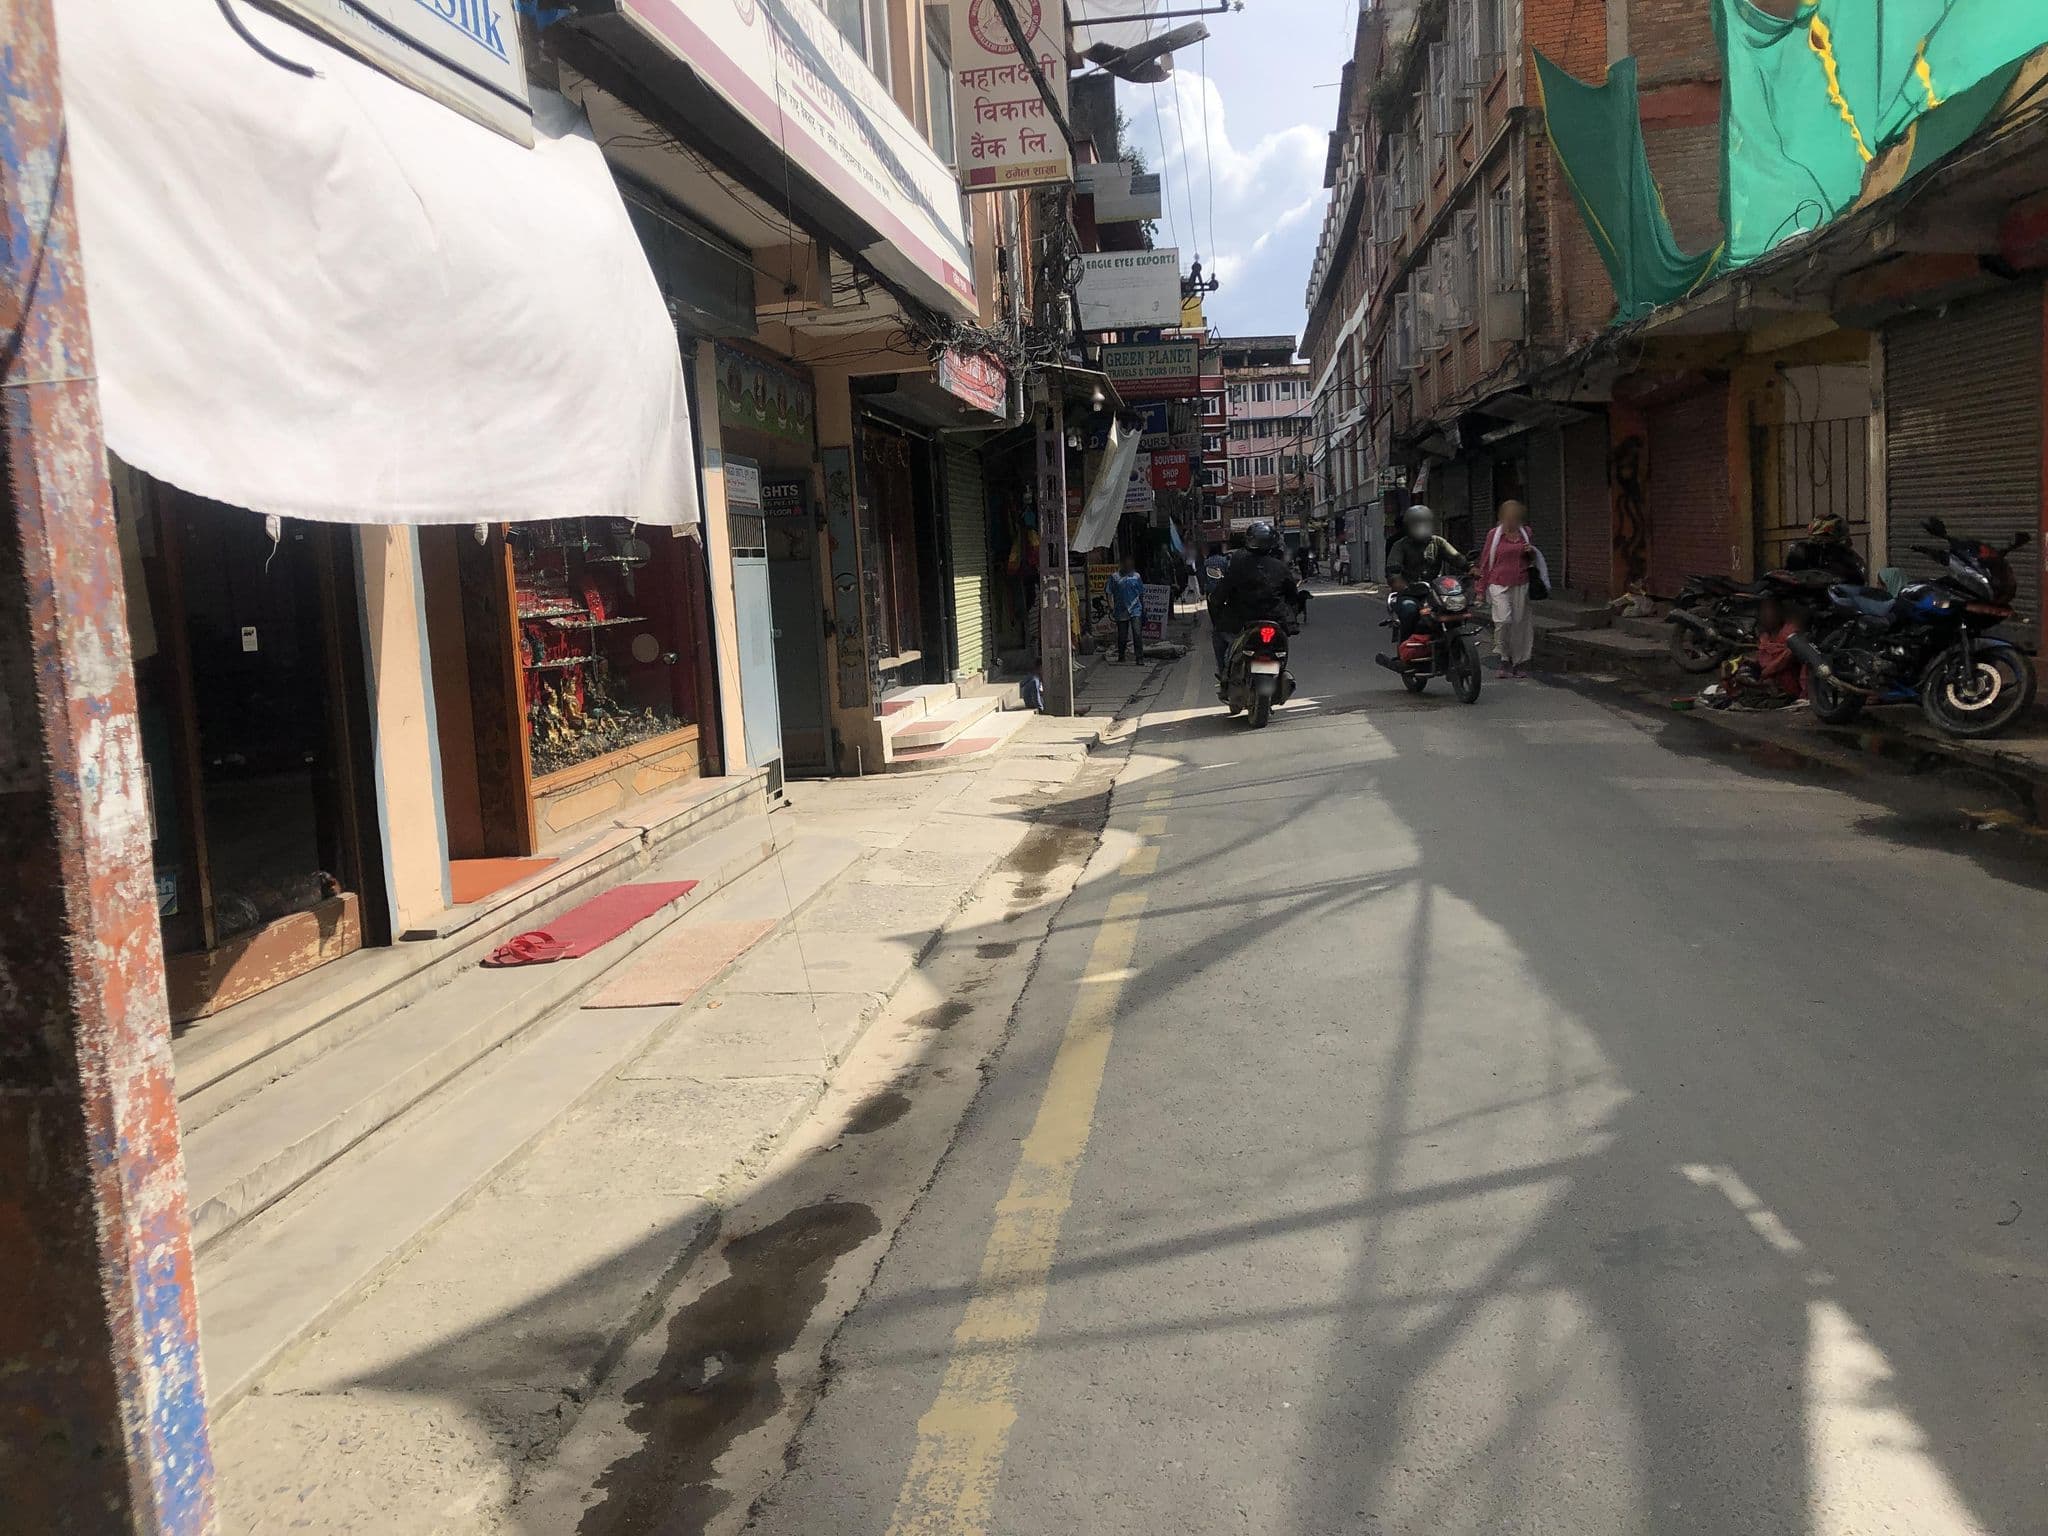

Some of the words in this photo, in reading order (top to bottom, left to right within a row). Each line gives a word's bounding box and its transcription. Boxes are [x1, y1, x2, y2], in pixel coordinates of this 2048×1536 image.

[974, 96, 1045, 124] विकास
[971, 132, 1007, 160] बैंक
[1115, 257, 1134, 268] EYES
[1137, 254, 1176, 266] EXPORTS
[1106, 351, 1144, 367] GREEN
[1149, 348, 1193, 364] PLANET
[1107, 368, 1136, 378] TRAVELS
[1146, 367, 1167, 376] TOURS
[1162, 468, 1179, 479] SHOP
